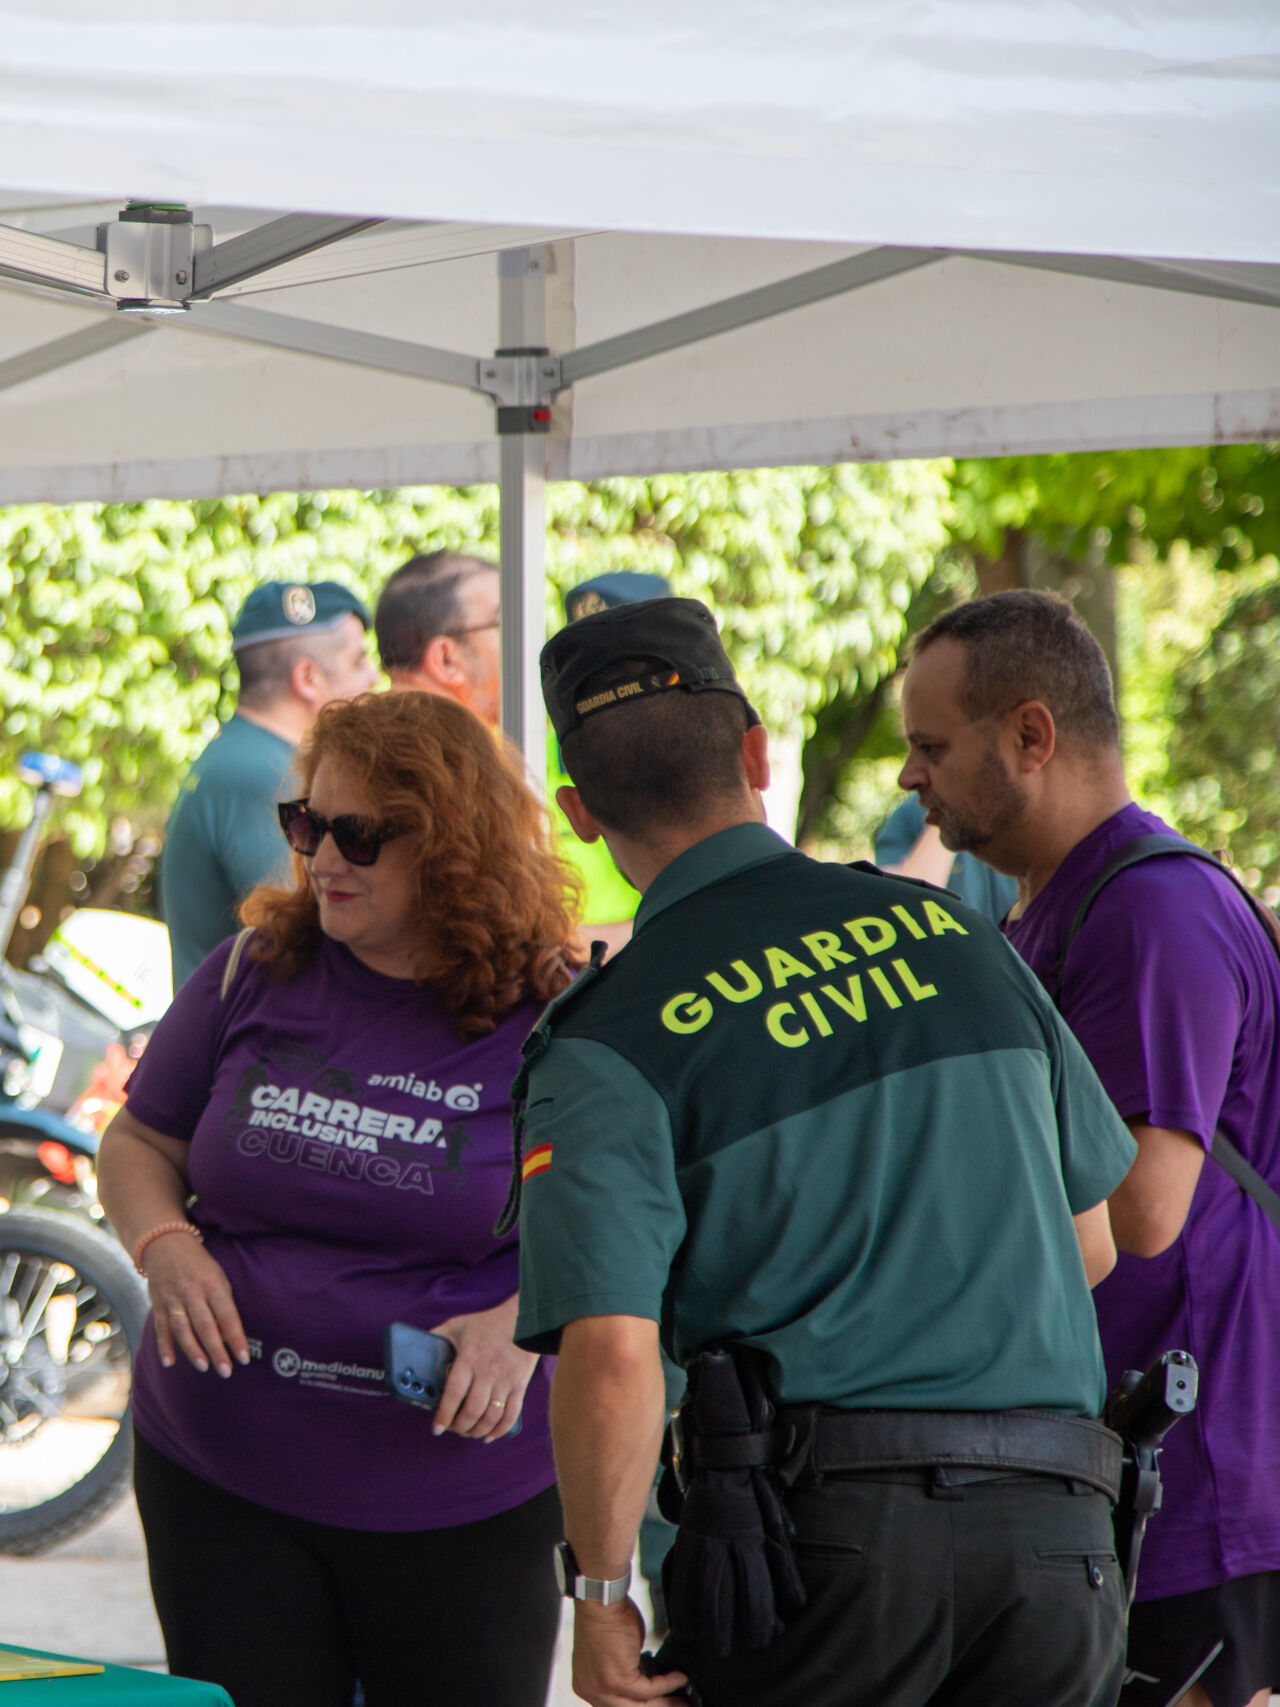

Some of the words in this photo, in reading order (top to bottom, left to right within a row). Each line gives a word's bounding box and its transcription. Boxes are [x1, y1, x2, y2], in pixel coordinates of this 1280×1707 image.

[576, 690, 617, 715] GUARDIA
[617, 681, 644, 698] CIVIL
[660, 900, 969, 1034] GUARDIA
[765, 958, 939, 1048] CIVIL
[368, 1072, 443, 1102] amiab
[248, 1110, 379, 1153] INCLUSIVA
[250, 1084, 447, 1148] CARRERA
[238, 1128, 434, 1195] CUENCA
[302, 1359, 385, 1381] mediolanu
